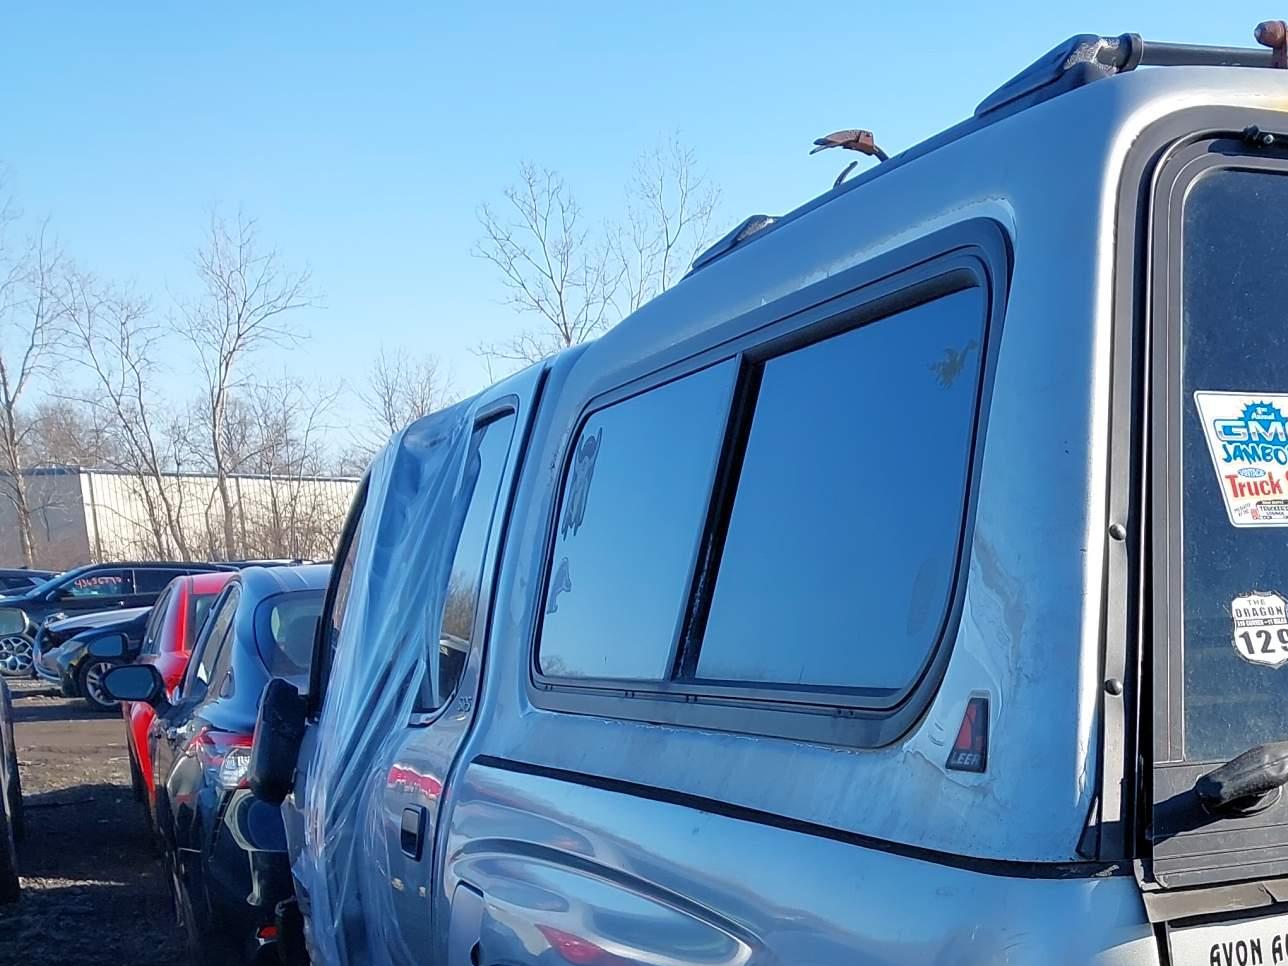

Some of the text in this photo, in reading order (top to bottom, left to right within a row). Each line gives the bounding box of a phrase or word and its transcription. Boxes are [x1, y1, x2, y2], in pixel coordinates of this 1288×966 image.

[1225, 471, 1283, 498] Truck
[1246, 598, 1266, 606] THE
[1234, 606, 1284, 618] DRAGON
[950, 752, 981, 766] LEER
